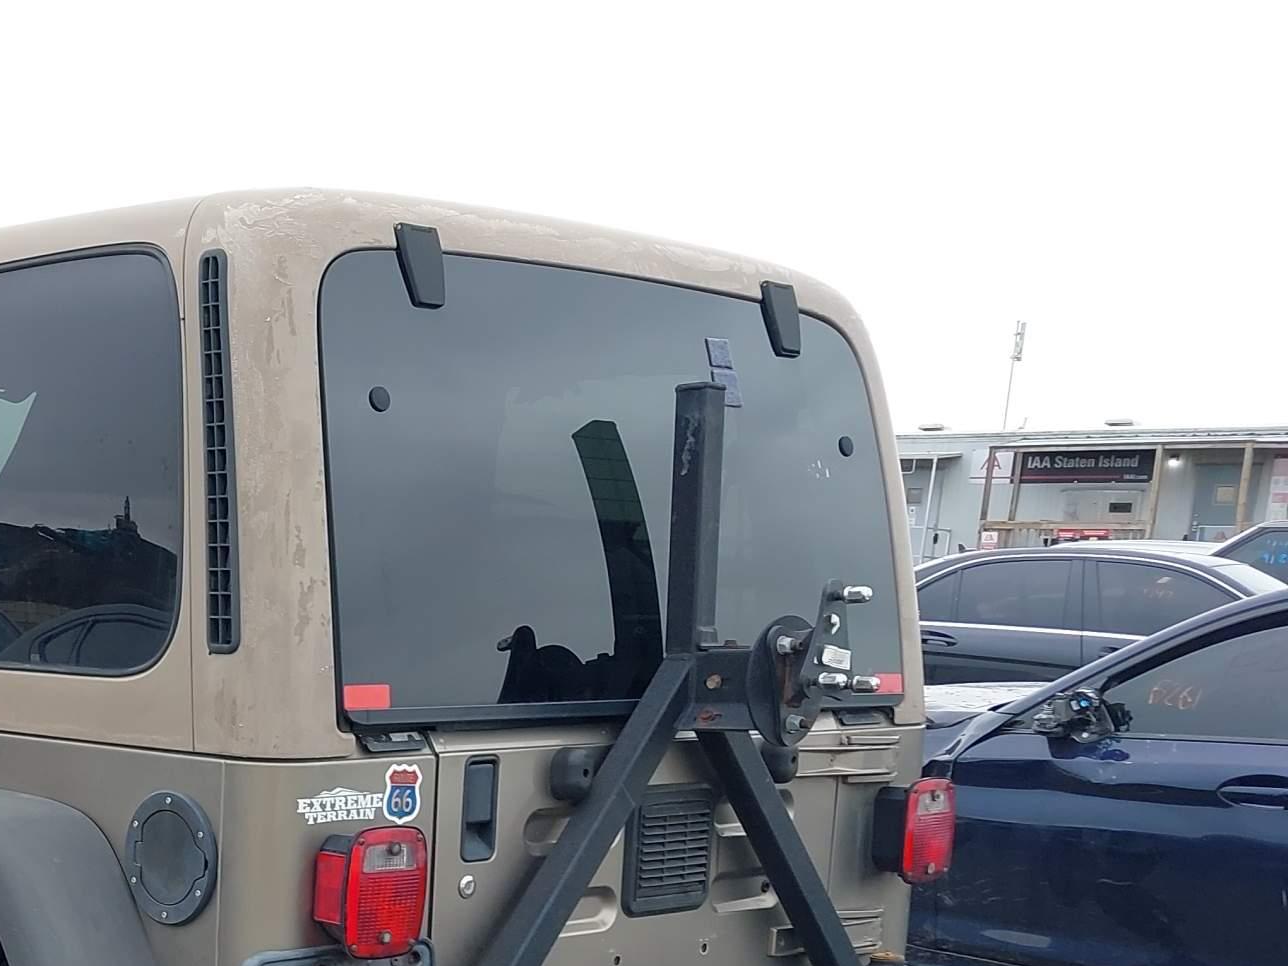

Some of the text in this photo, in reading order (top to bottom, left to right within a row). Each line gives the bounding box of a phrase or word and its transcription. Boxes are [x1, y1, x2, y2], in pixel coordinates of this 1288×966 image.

[1027, 454, 1139, 469] IAA Staten Island
[296, 793, 384, 813] EXTREME
[392, 789, 413, 812] 66
[304, 808, 376, 825] TERRAIN
